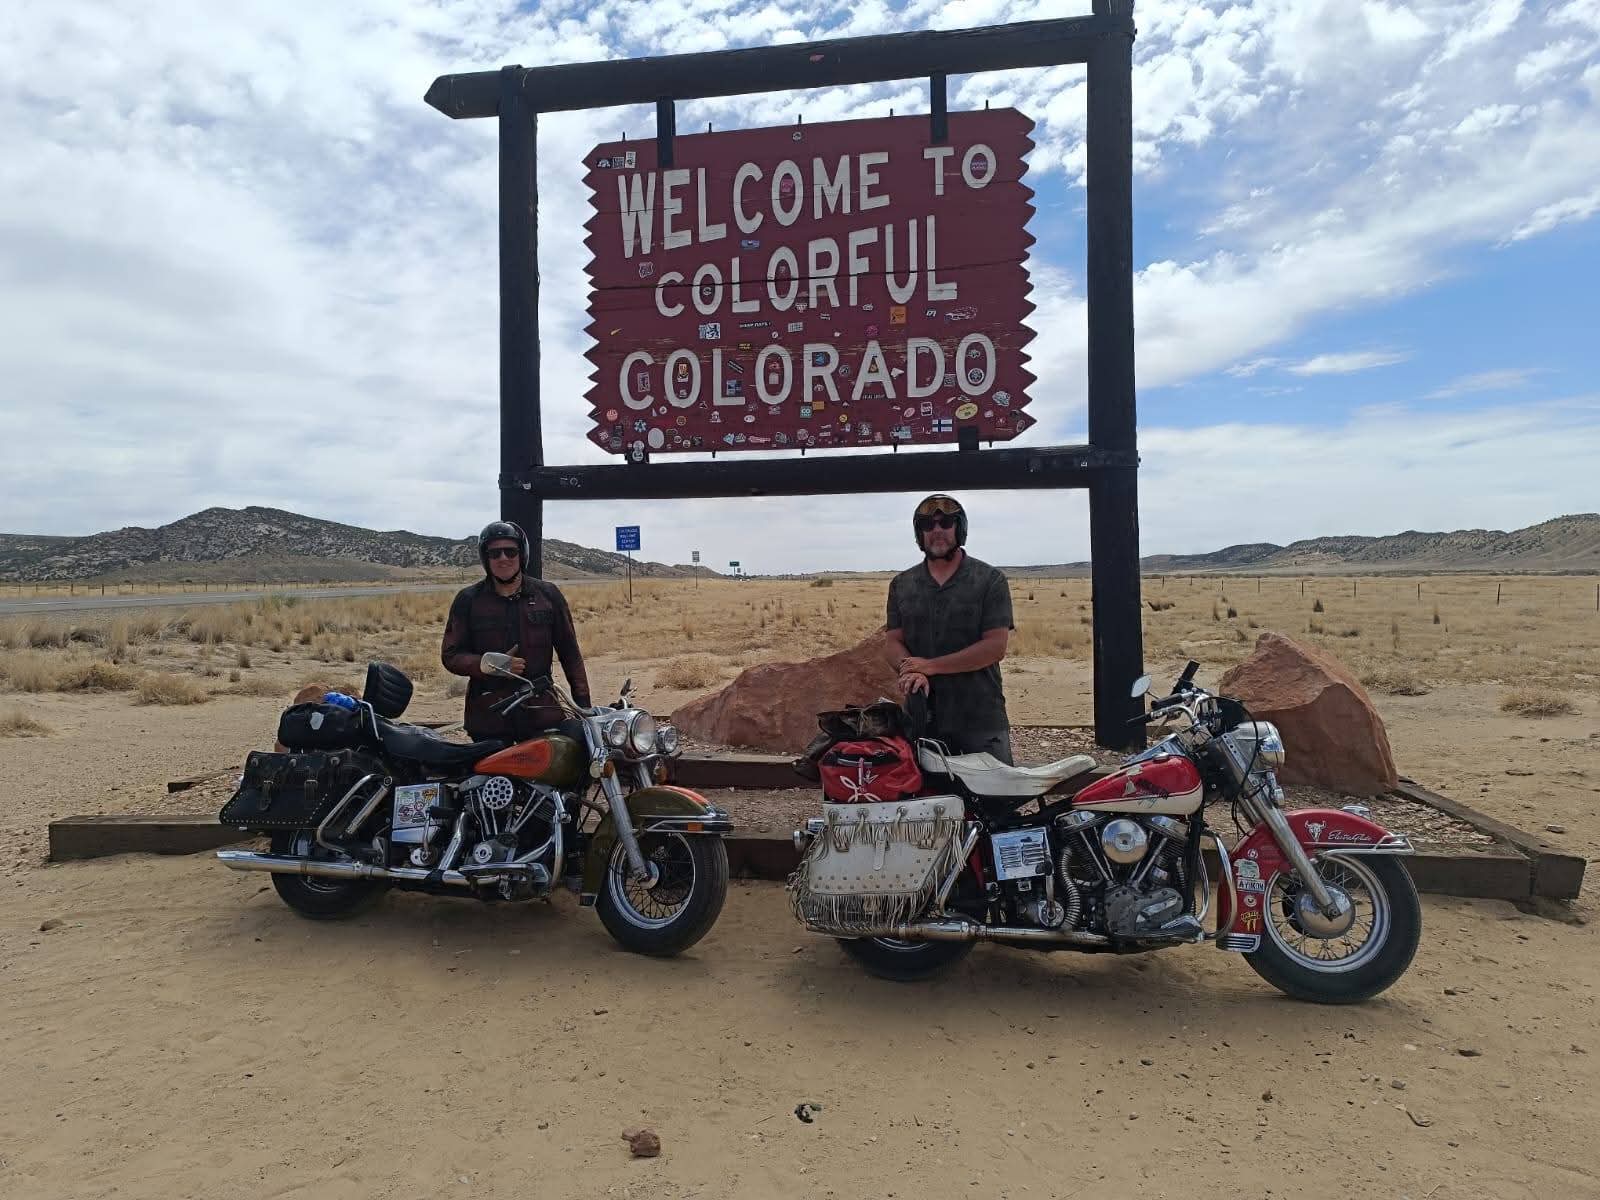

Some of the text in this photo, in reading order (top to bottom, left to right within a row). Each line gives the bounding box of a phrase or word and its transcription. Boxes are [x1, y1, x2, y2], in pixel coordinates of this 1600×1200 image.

[617, 143, 997, 258] WELCOME TO
[655, 215, 958, 317] COLORFUL
[619, 333, 996, 410] COLORADO
